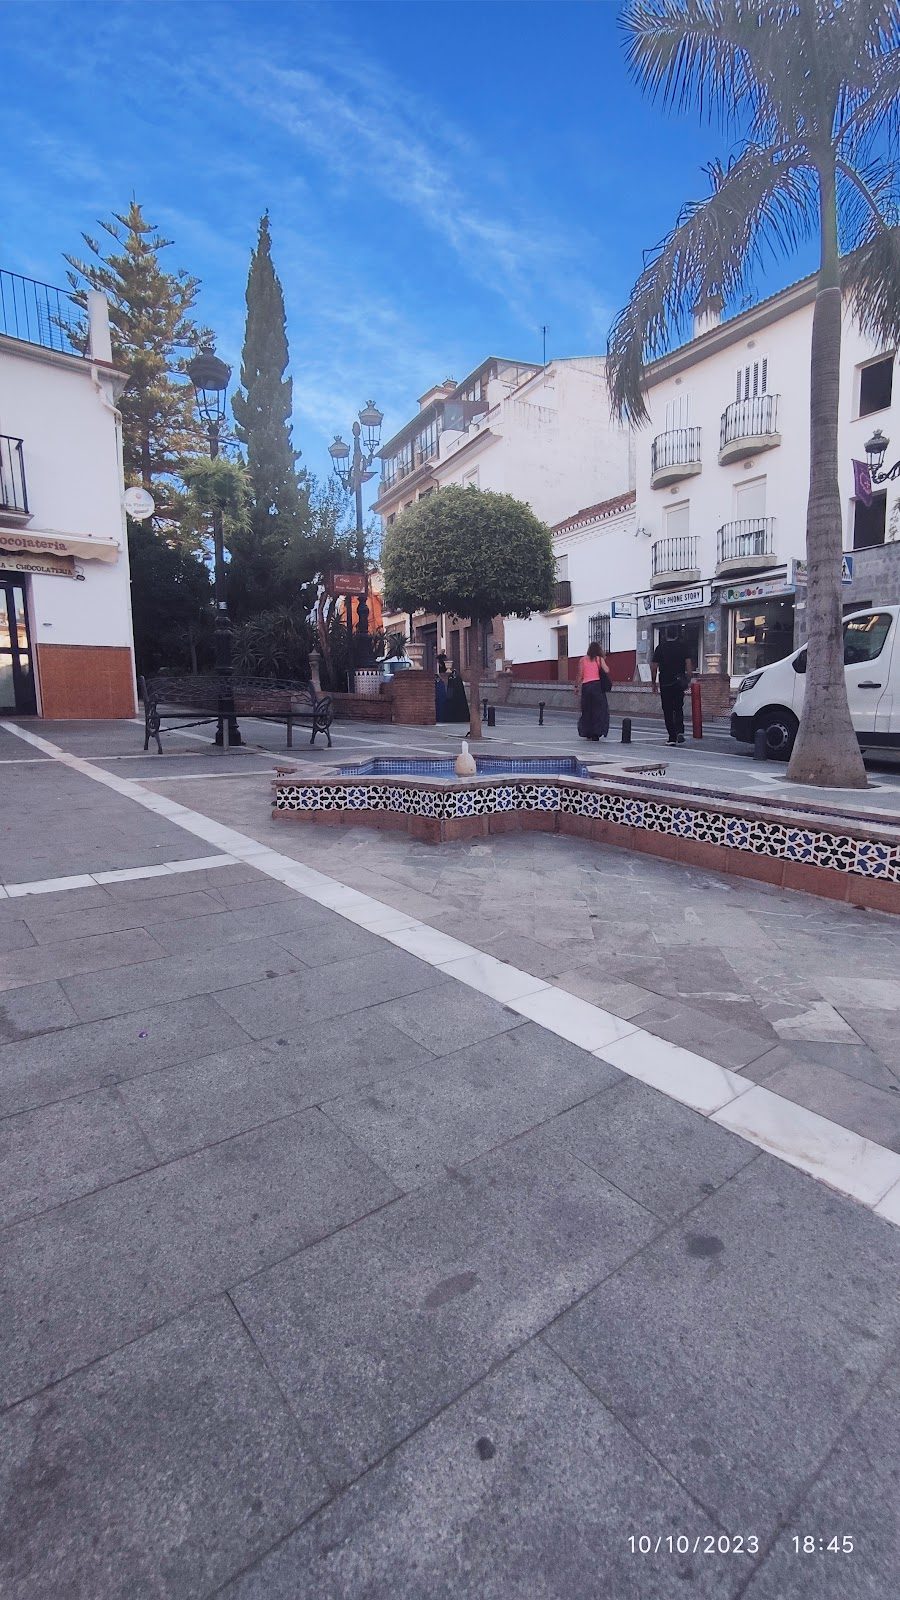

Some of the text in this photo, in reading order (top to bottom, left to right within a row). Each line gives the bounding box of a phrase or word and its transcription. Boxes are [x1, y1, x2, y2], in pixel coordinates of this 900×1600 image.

[16, 563, 73, 576] CHOCOLATERIA
[657, 592, 700, 606] THE PHONE STORY
